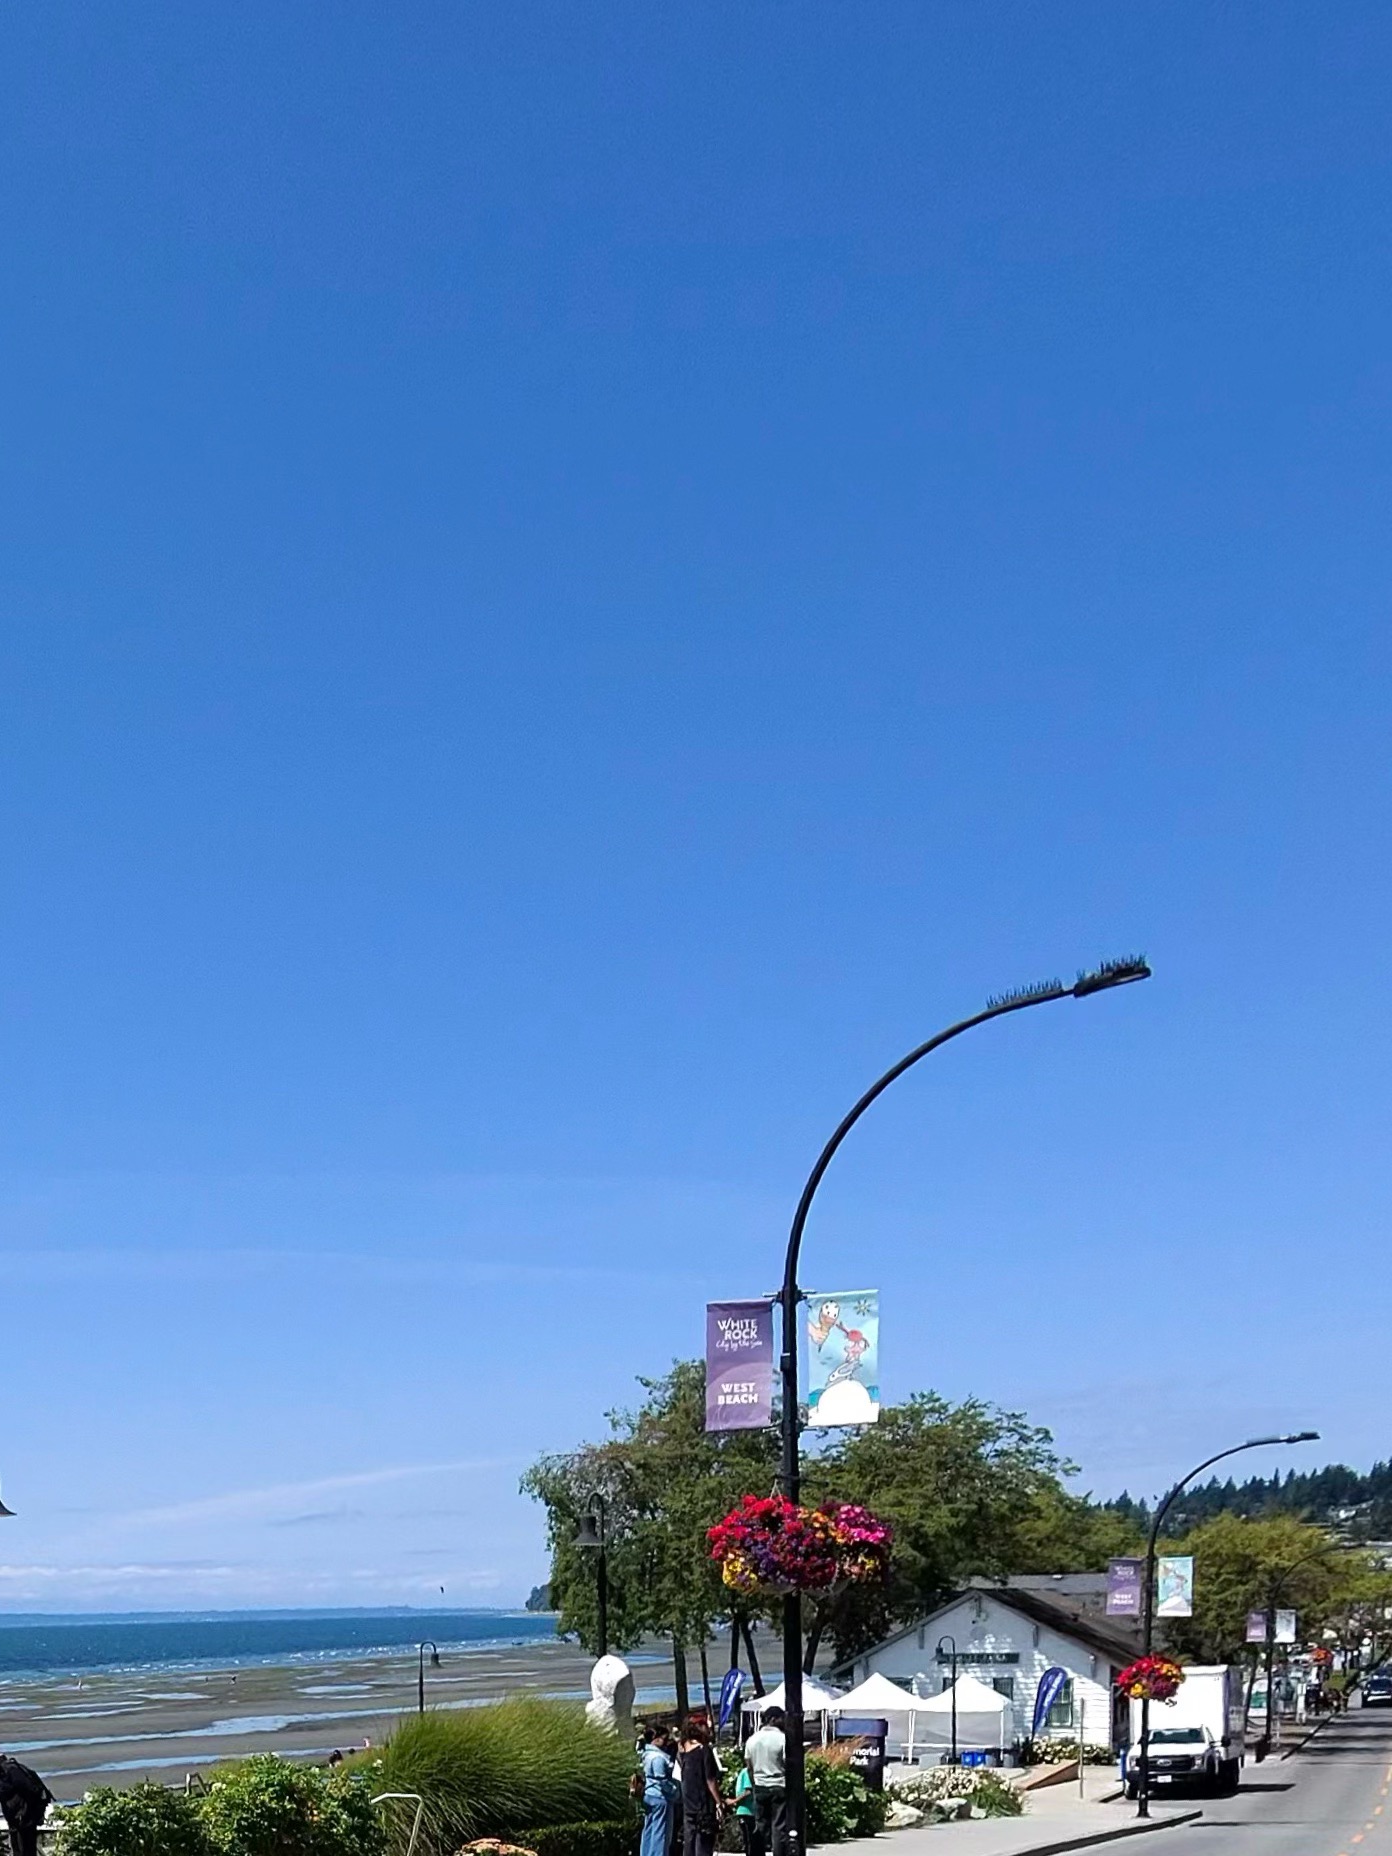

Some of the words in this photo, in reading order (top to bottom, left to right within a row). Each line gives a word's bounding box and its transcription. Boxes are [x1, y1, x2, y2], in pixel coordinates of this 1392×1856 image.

[717, 1317, 758, 1331] WHITE
[724, 1328, 758, 1340] ROCK
[721, 1382, 755, 1393] WEST
[717, 1393, 758, 1405] BEACH
